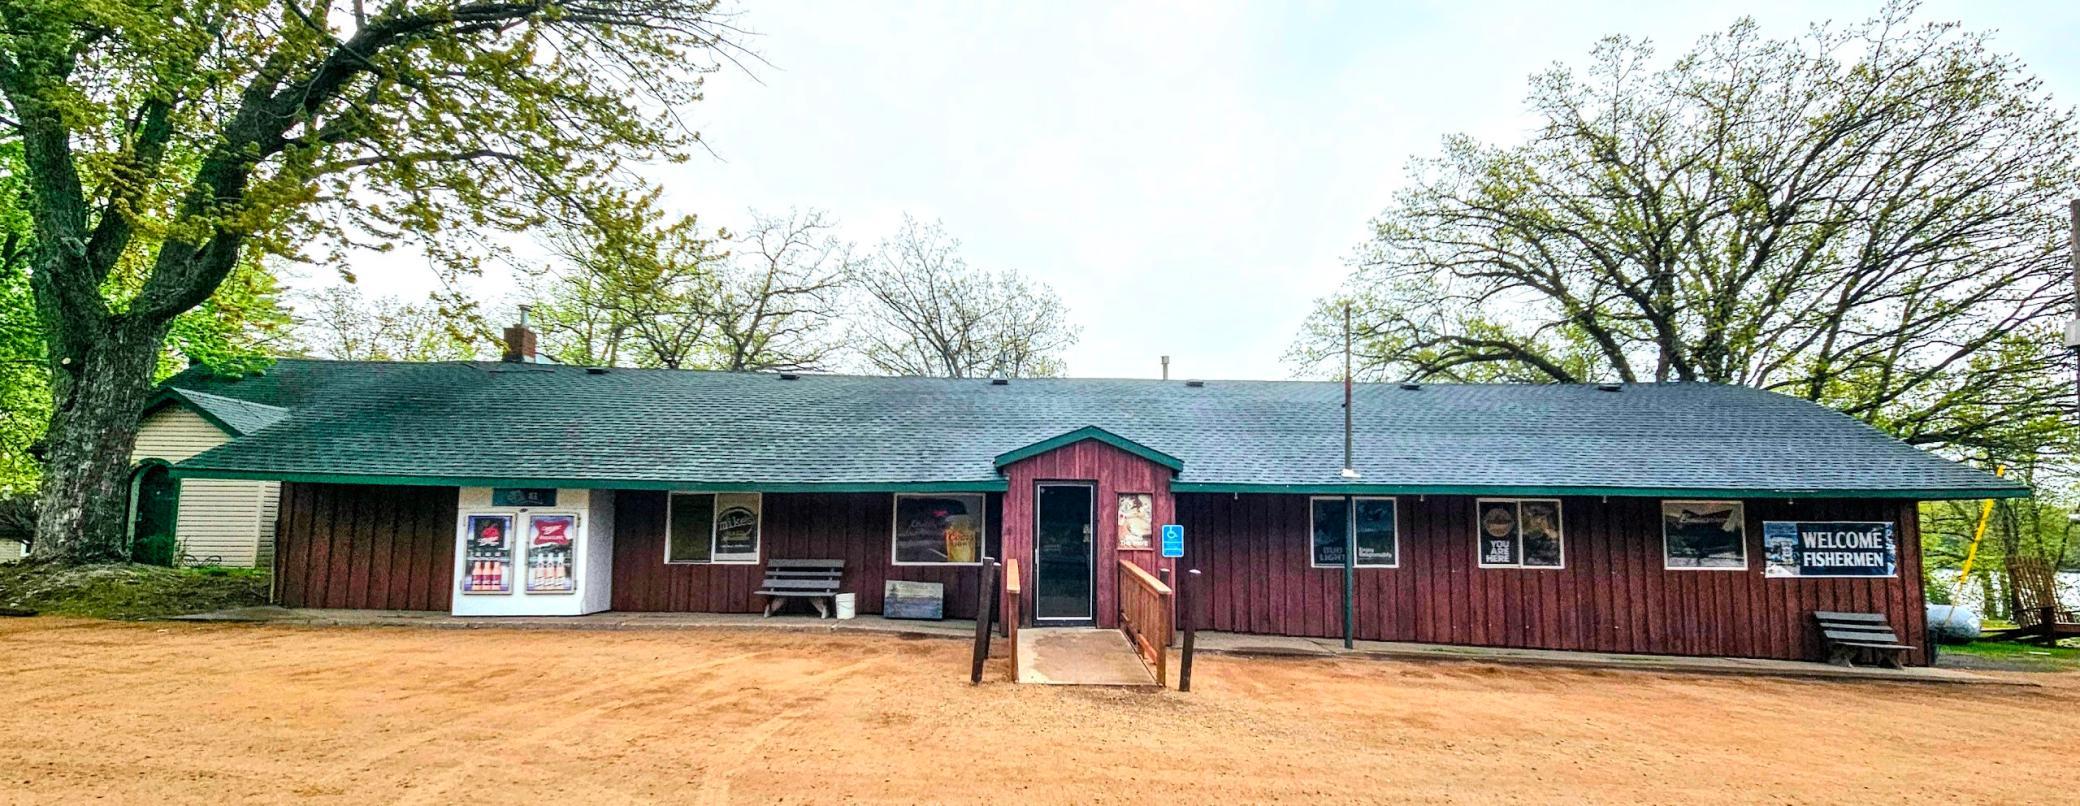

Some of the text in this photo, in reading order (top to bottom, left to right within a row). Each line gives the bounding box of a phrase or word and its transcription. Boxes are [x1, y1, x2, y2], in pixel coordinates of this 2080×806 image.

[1490, 540, 1510, 548] YOU
[1802, 531, 1883, 549] WELCOME
[1490, 547, 1510, 555] ARE
[1486, 554, 1510, 563] HERE
[1802, 552, 1884, 567] FISHERMEN
